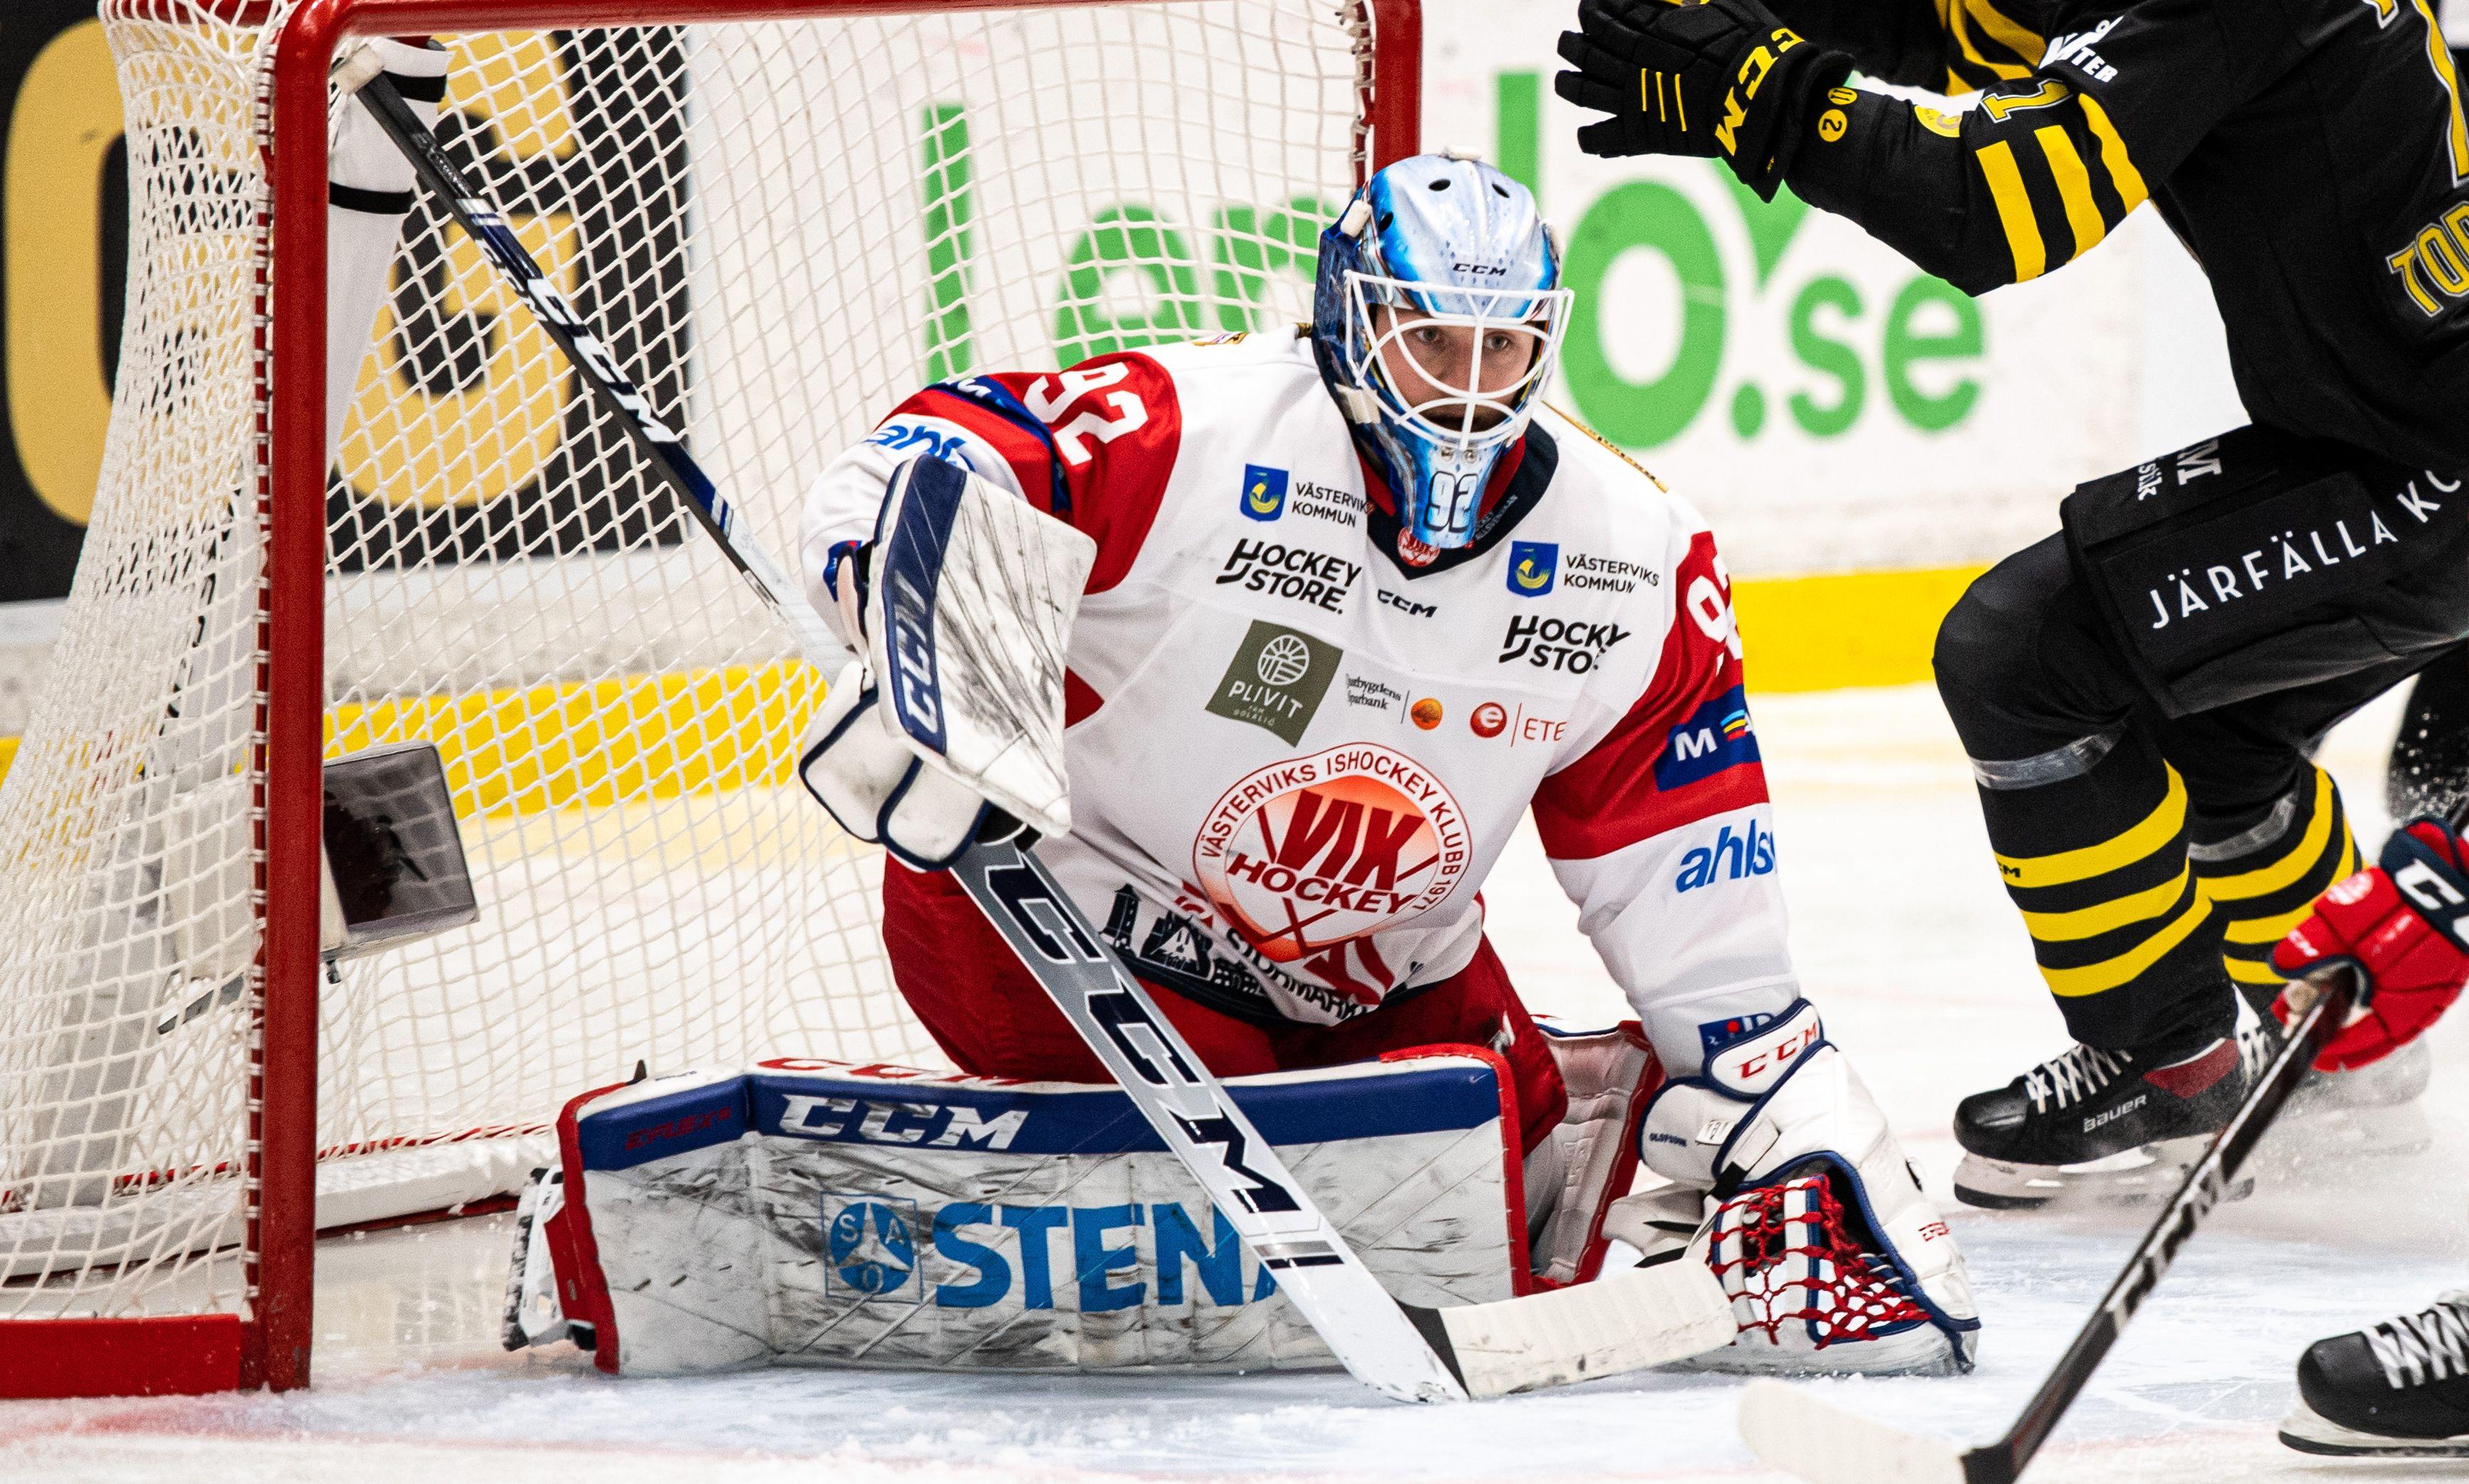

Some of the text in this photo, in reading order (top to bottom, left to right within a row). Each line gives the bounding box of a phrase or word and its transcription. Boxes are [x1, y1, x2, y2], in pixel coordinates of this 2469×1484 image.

[1715, 28, 1806, 156] CCM
[1453, 261, 1507, 277] CCM
[527, 278, 679, 443] CCM
[1023, 361, 1149, 466] 92
[1292, 500, 1357, 527] KOMMUN
[1425, 470, 1479, 533] 92
[1223, 538, 1362, 587] HOCKEY
[1564, 573, 1636, 594] KOMMUN
[1566, 554, 1660, 586] VÄSTERVIKS
[2149, 510, 2399, 629] JÄRFÄLLA
[1245, 569, 1344, 614] STORE.
[1377, 589, 1438, 618] CCM
[1503, 615, 1632, 648] HOCKY
[1228, 680, 1304, 718] PLIVIT
[1201, 764, 1317, 859] VÄSTERVIKS
[1326, 751, 1437, 803] ISHOCKEY
[1430, 800, 1463, 876] KLUBB
[1280, 789, 1427, 891] VIK
[1227, 853, 1419, 914] HOCKEY
[984, 849, 1303, 1214] CCM
[1738, 1022, 1818, 1079] CCM
[779, 1093, 1030, 1149] CCM
[931, 1200, 1281, 1312] STEN
